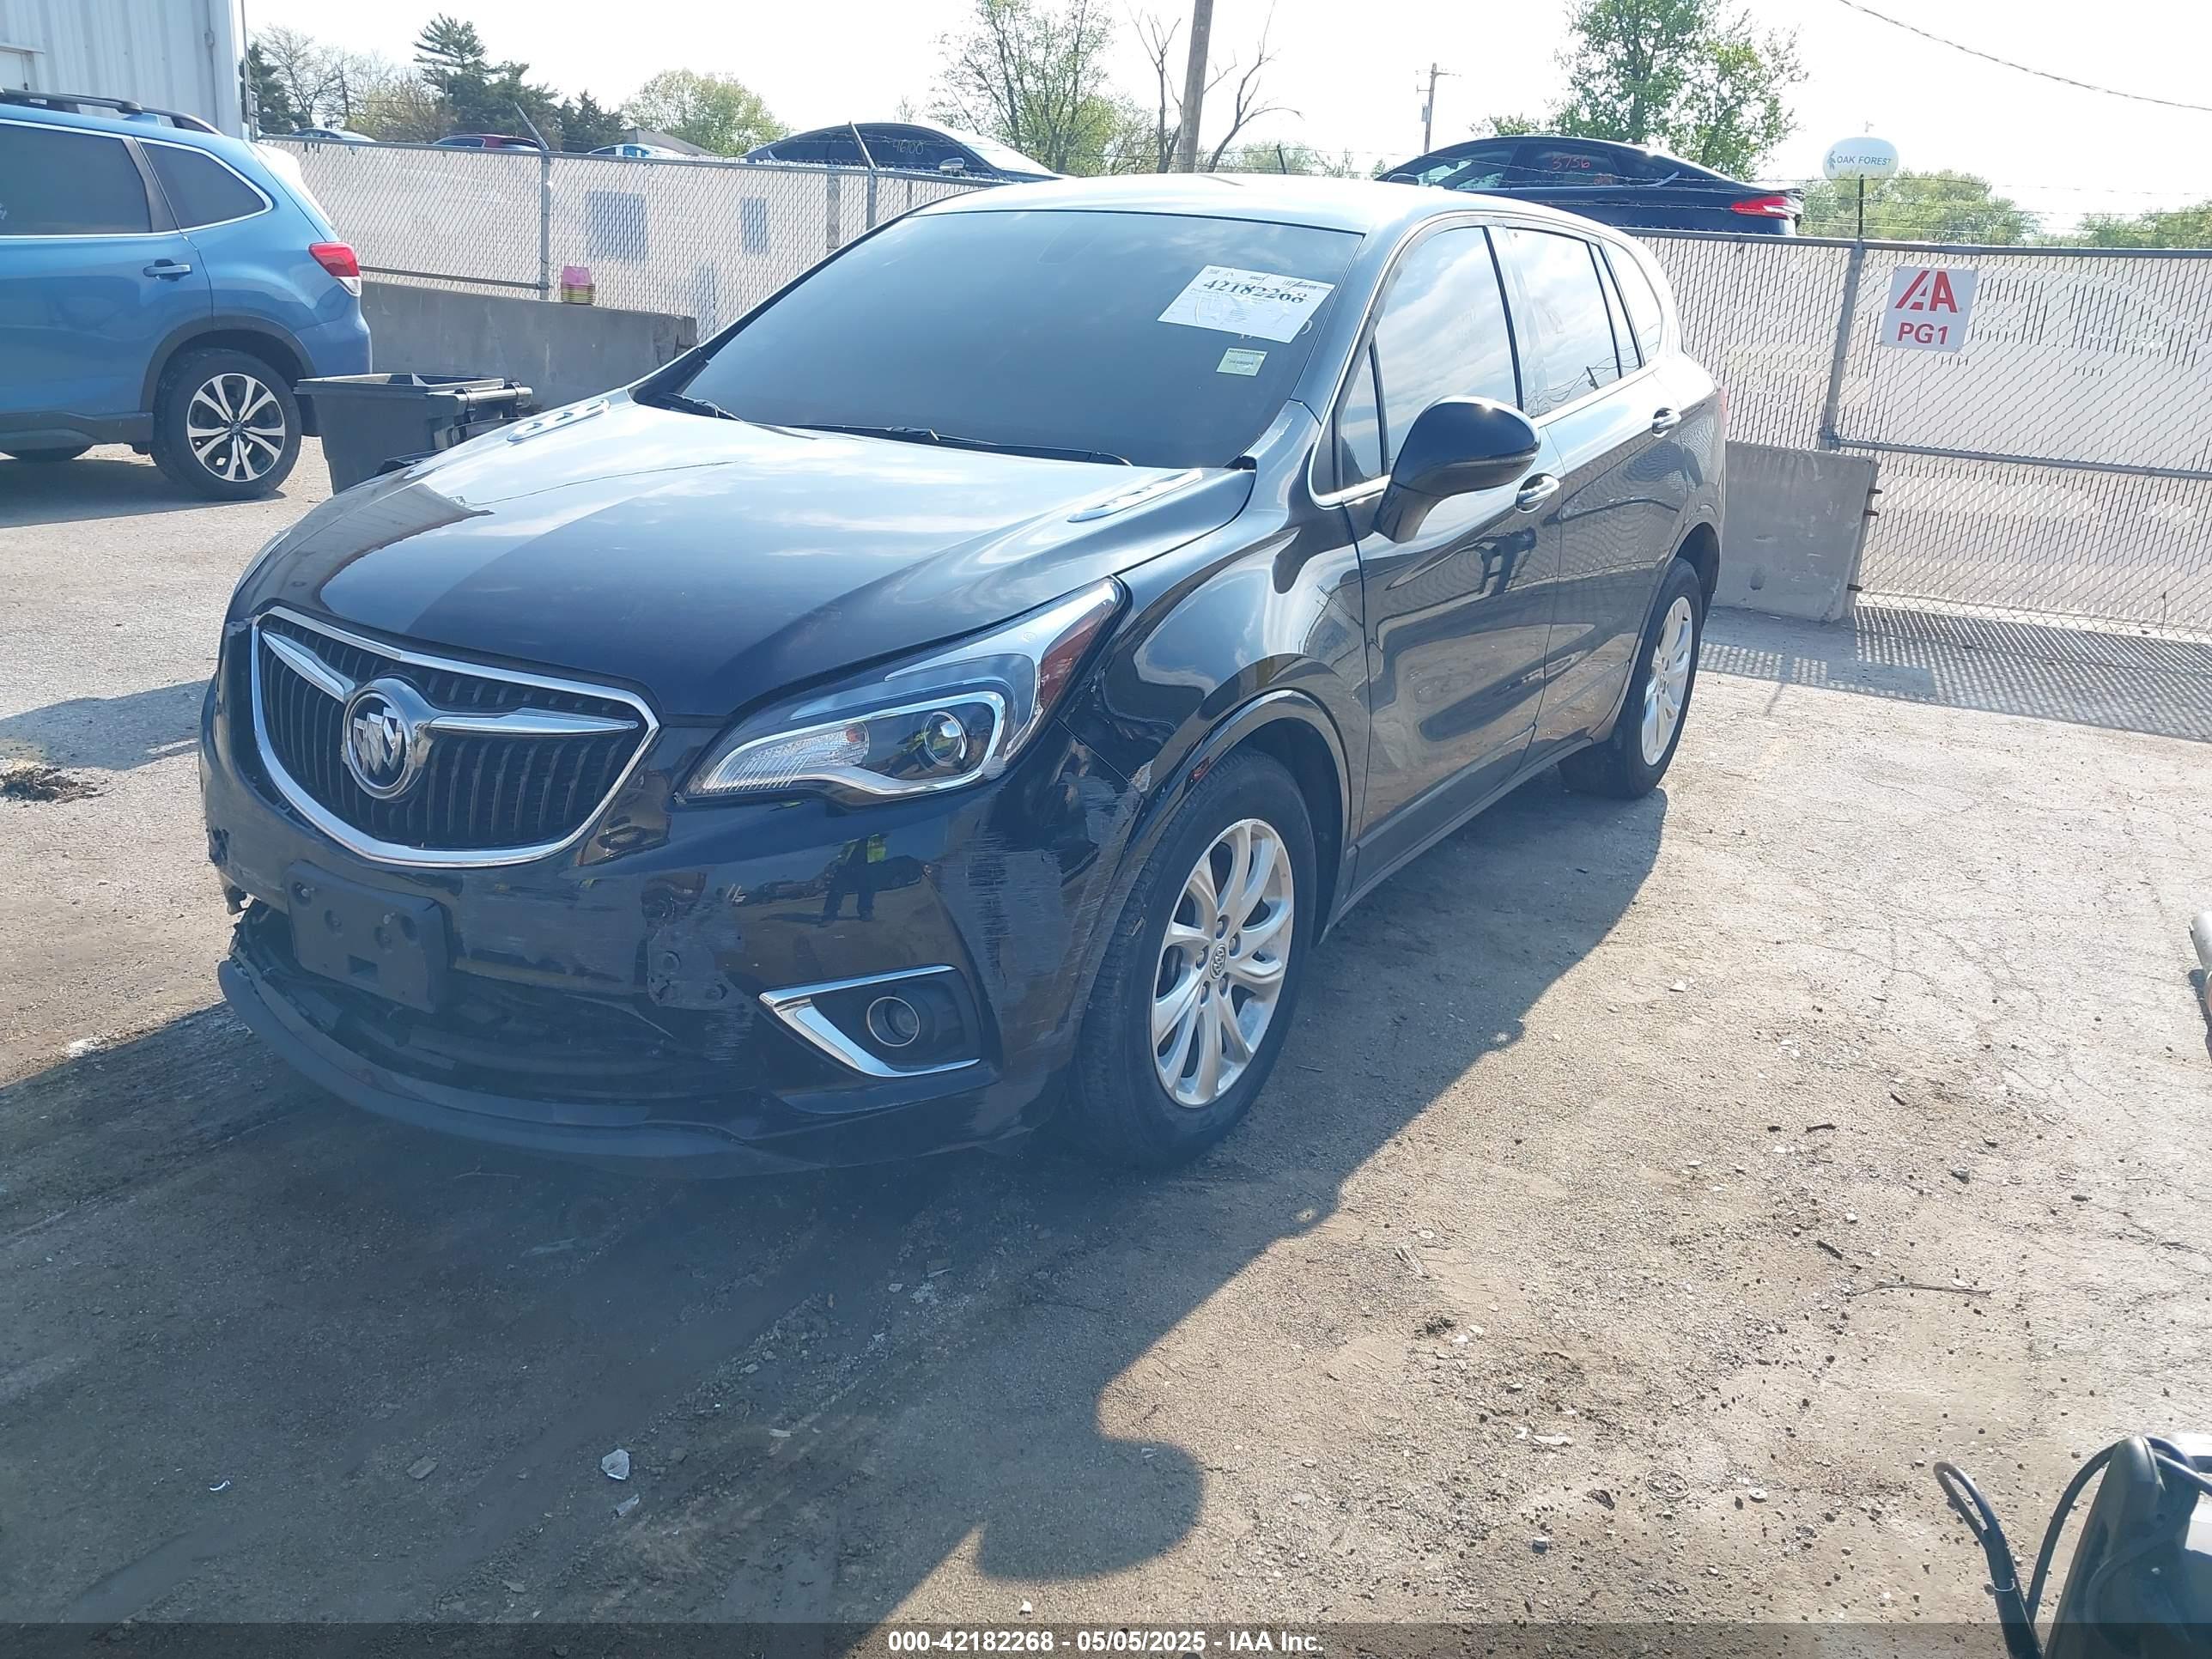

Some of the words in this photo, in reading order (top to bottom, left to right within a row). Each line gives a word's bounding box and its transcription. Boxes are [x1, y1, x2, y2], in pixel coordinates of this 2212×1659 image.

[1837, 155, 1855, 164] OAK
[1858, 156, 1892, 166] FOREST
[1897, 322, 1948, 344] PG1
